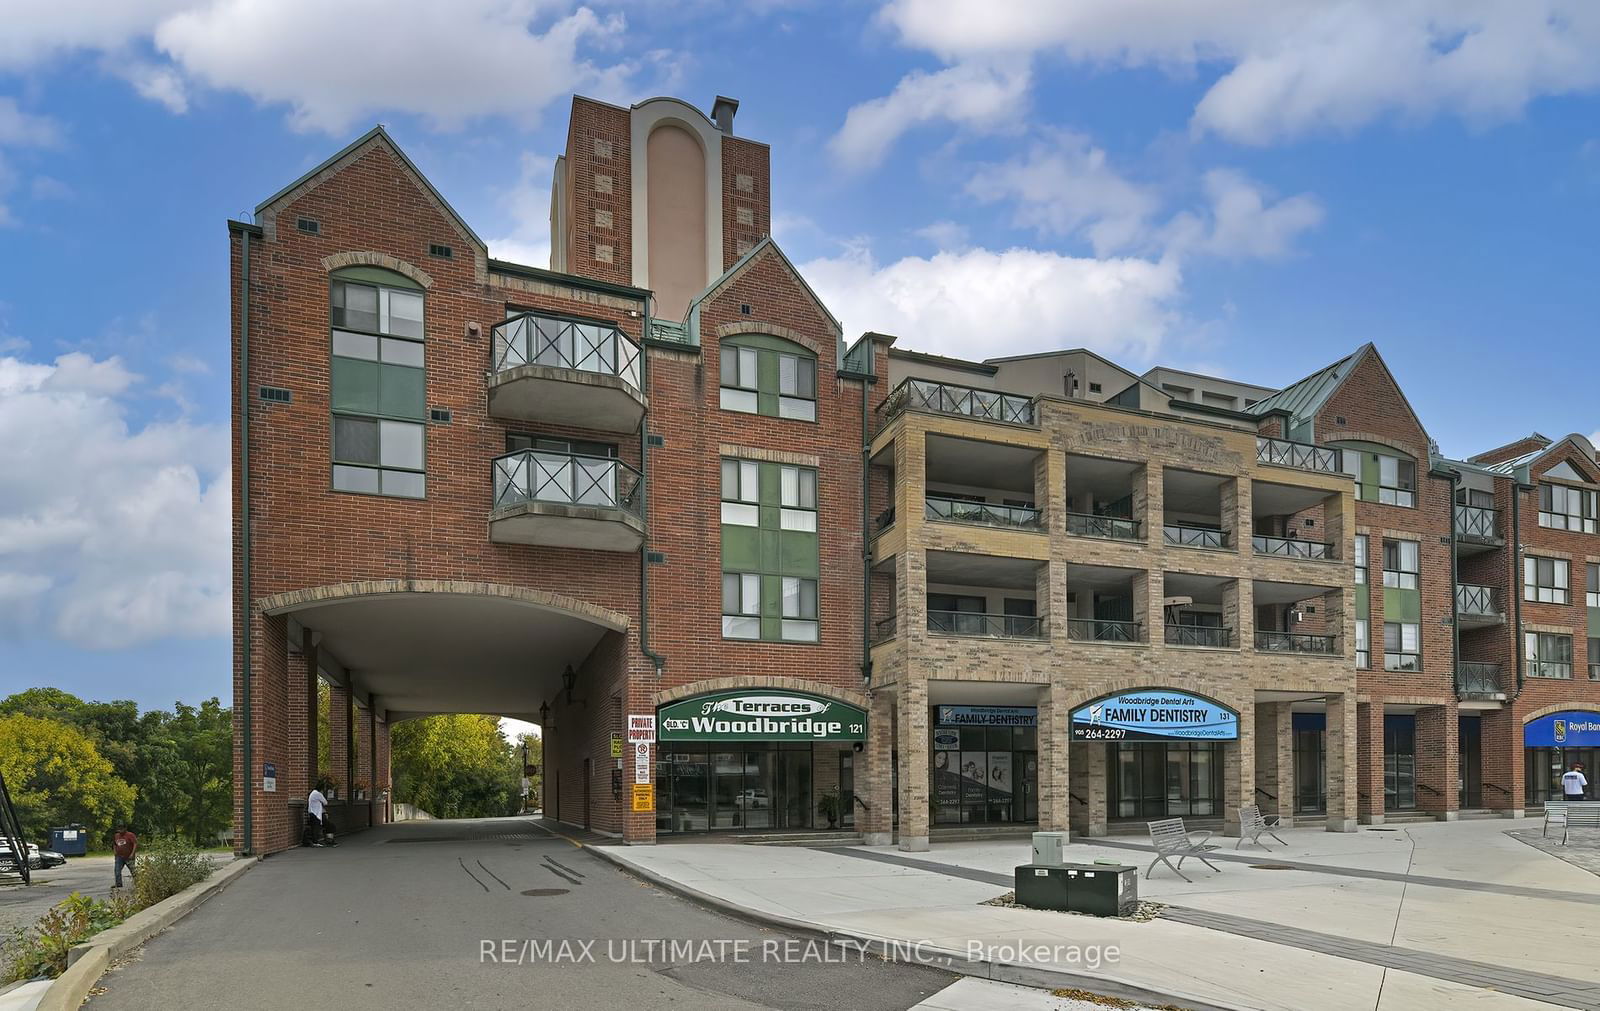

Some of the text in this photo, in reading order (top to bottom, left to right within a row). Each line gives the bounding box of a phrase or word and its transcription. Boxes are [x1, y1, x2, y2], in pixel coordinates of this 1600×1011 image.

[1118, 697, 1195, 706] Woodbridge Dental Arts
[701, 700, 832, 715] The Terraces of
[955, 713, 1034, 725] FAMILY DENTISTRY
[1105, 708, 1208, 722] FAMILY DENTISTRY
[1219, 712, 1230, 721] 131
[631, 717, 653, 729] PRIVATE
[666, 720, 680, 729] BLD.
[692, 717, 841, 736] Woodbridge
[848, 723, 863, 734] 121
[1569, 722, 1587, 733] Royal
[629, 729, 655, 740] PROPERTY
[1085, 729, 1126, 739] 264-2297
